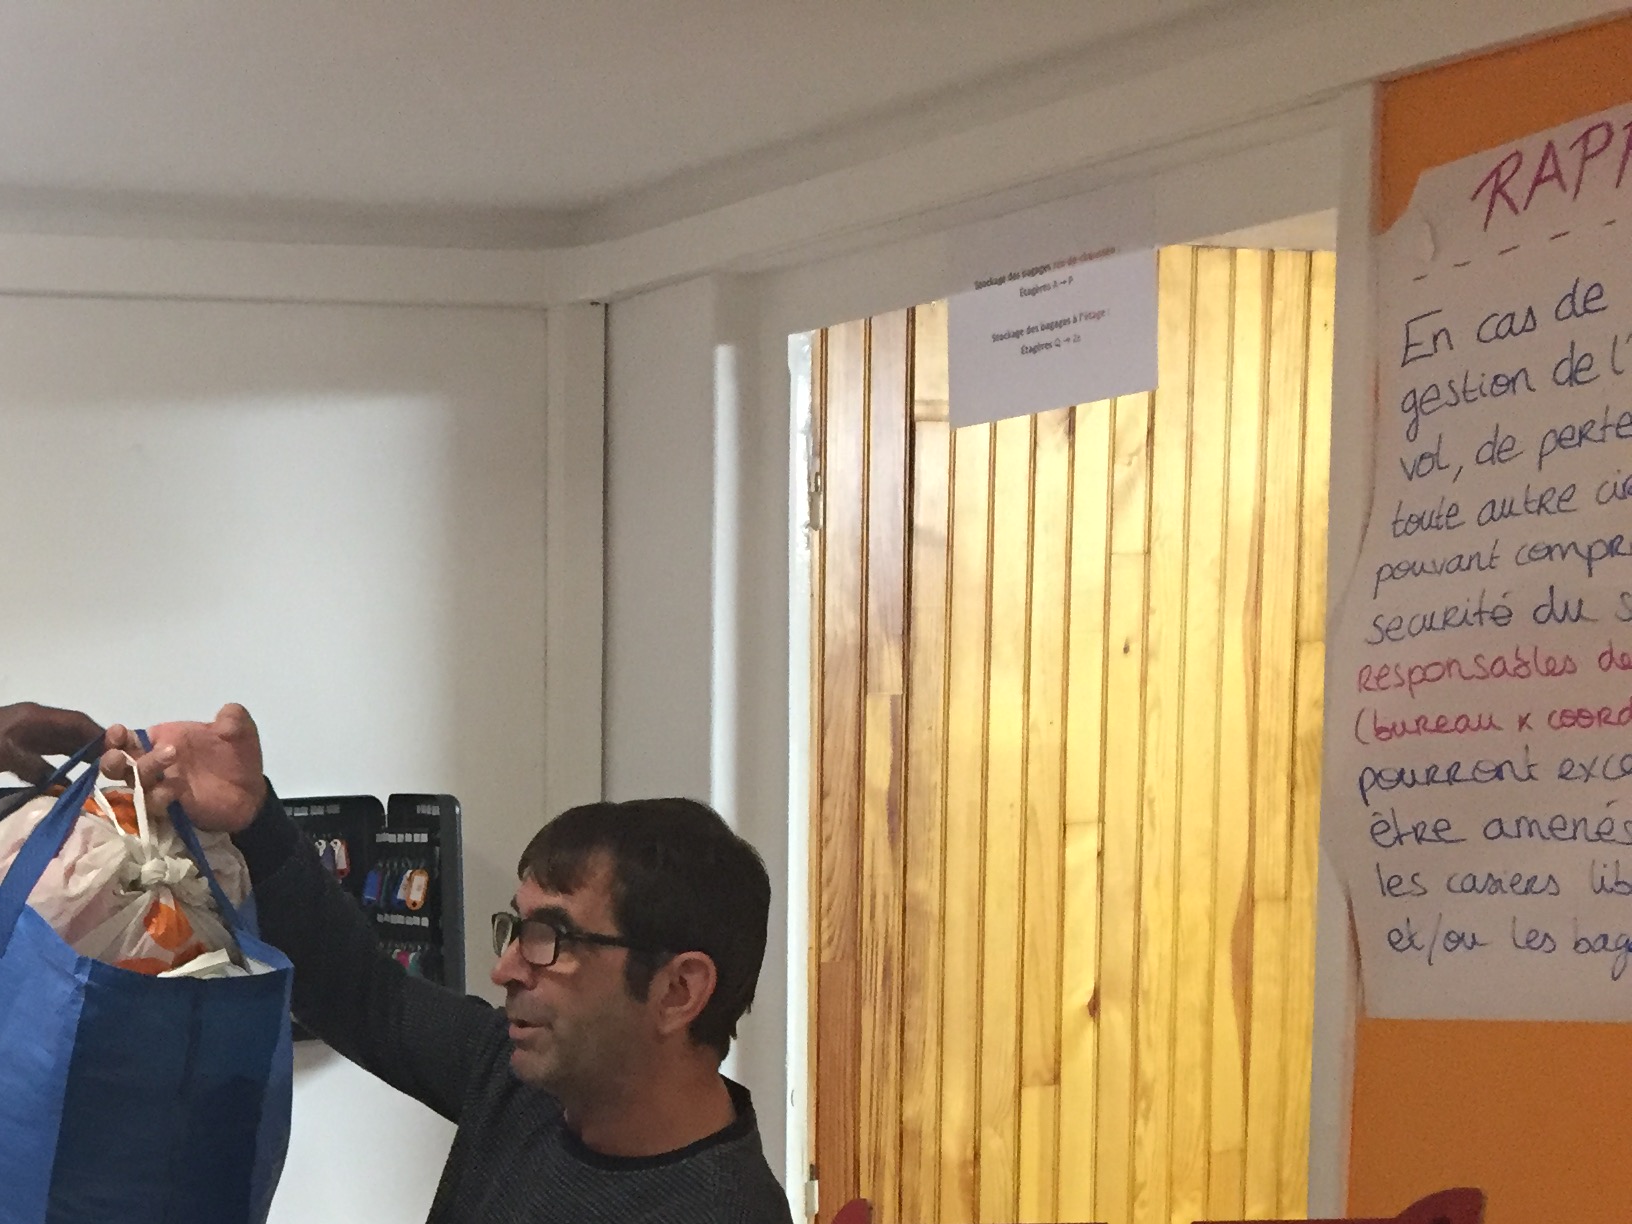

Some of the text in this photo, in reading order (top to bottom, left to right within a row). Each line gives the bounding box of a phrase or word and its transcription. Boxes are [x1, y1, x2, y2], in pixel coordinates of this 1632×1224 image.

[1401, 277, 1608, 367] En cas de
[1401, 367, 1536, 442] gestion
[1553, 340, 1600, 387] de
[1400, 433, 1463, 483] vol,
[1475, 423, 1524, 465] de
[1391, 496, 1466, 538] toute
[1477, 483, 1577, 526] autre
[1373, 538, 1500, 600] pouvant
[1533, 584, 1599, 625] du
[1359, 744, 1539, 807] pourront
[1369, 807, 1467, 848] être
[1376, 863, 1428, 897] les
[1512, 916, 1557, 954] les
